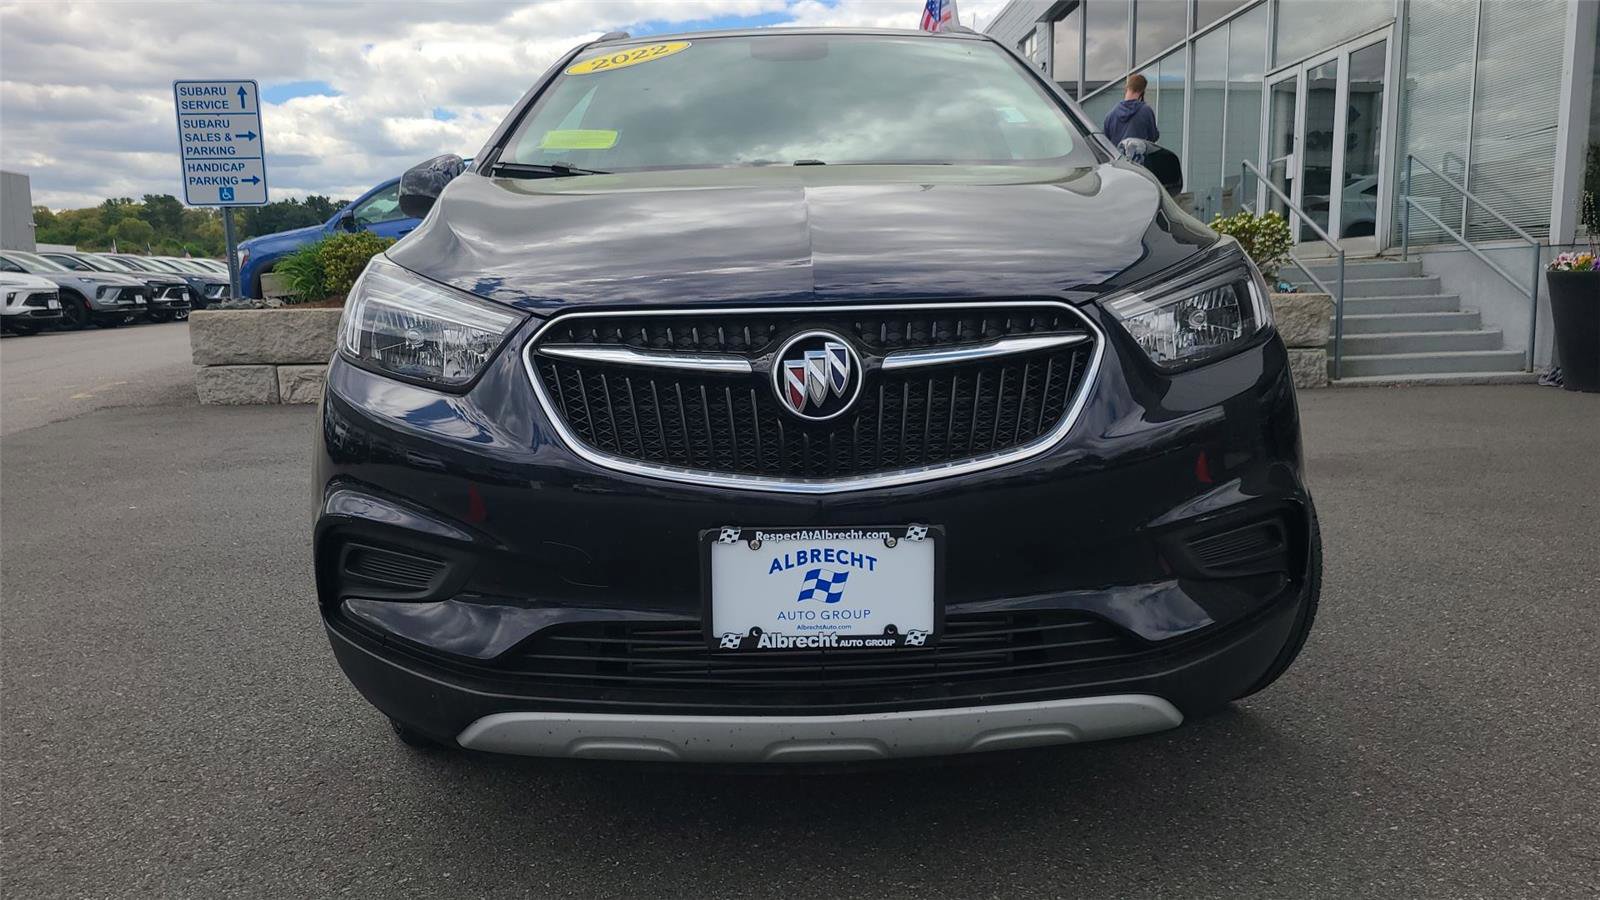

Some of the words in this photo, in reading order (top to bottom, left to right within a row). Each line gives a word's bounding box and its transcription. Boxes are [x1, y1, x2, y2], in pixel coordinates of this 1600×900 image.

[591, 45, 669, 71] 2022
[180, 86, 227, 96] SUBARU
[181, 100, 229, 110] SERVICE
[183, 119, 230, 129] SUBARU
[184, 133, 221, 142] SALES
[224, 132, 232, 142] &
[186, 146, 236, 155] PARKING
[188, 162, 245, 172] HANDICAP
[189, 176, 239, 185] PARKING
[755, 529, 890, 542] RespectAtAlbrecht.com
[768, 548, 878, 575] ALBRECHT
[777, 610, 817, 621] AUTO
[820, 609, 871, 620] GROUP
[796, 623, 852, 631] AlbrechtAuto.com
[757, 632, 838, 650] Albrecht
[839, 637, 864, 648] AUTO
[865, 638, 896, 647] GROUP
